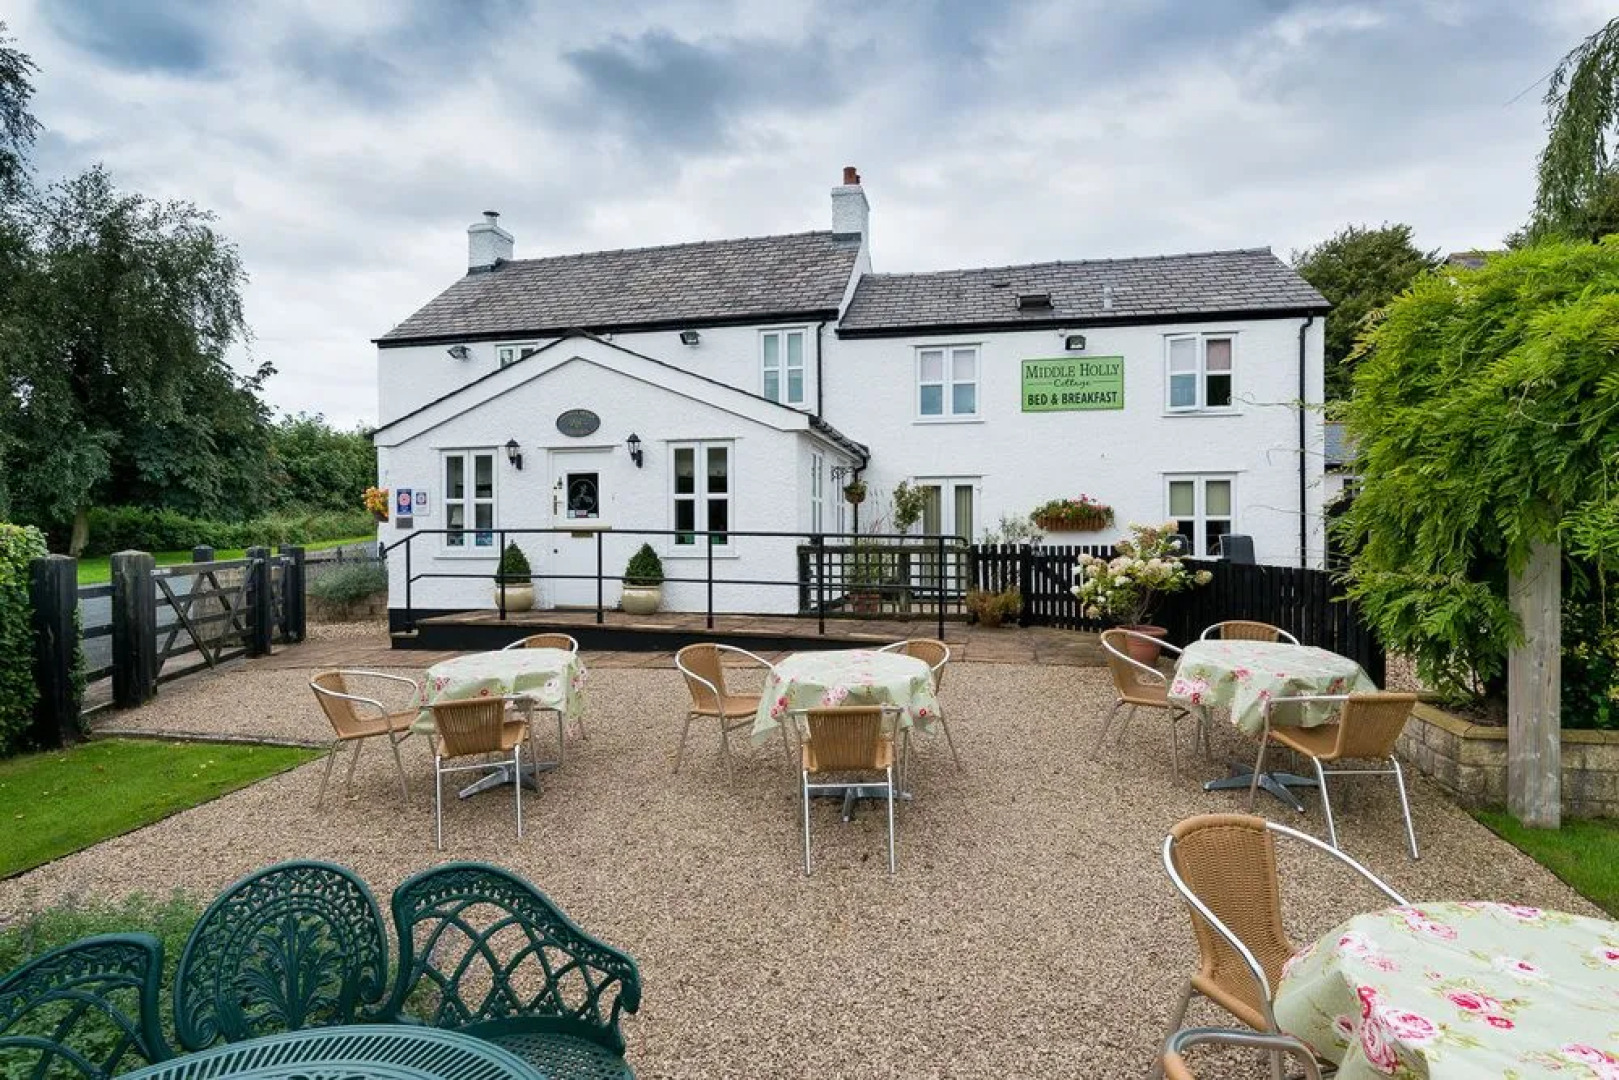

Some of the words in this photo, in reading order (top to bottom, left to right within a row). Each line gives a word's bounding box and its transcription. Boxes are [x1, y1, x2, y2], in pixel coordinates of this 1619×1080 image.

[1025, 365, 1076, 379] MIDDLE
[1079, 363, 1120, 377] HOLLY
[1053, 378, 1090, 388] Cottage
[1027, 393, 1048, 405] BED
[1050, 392, 1059, 405] &
[1061, 391, 1118, 404] BREAKFAST
